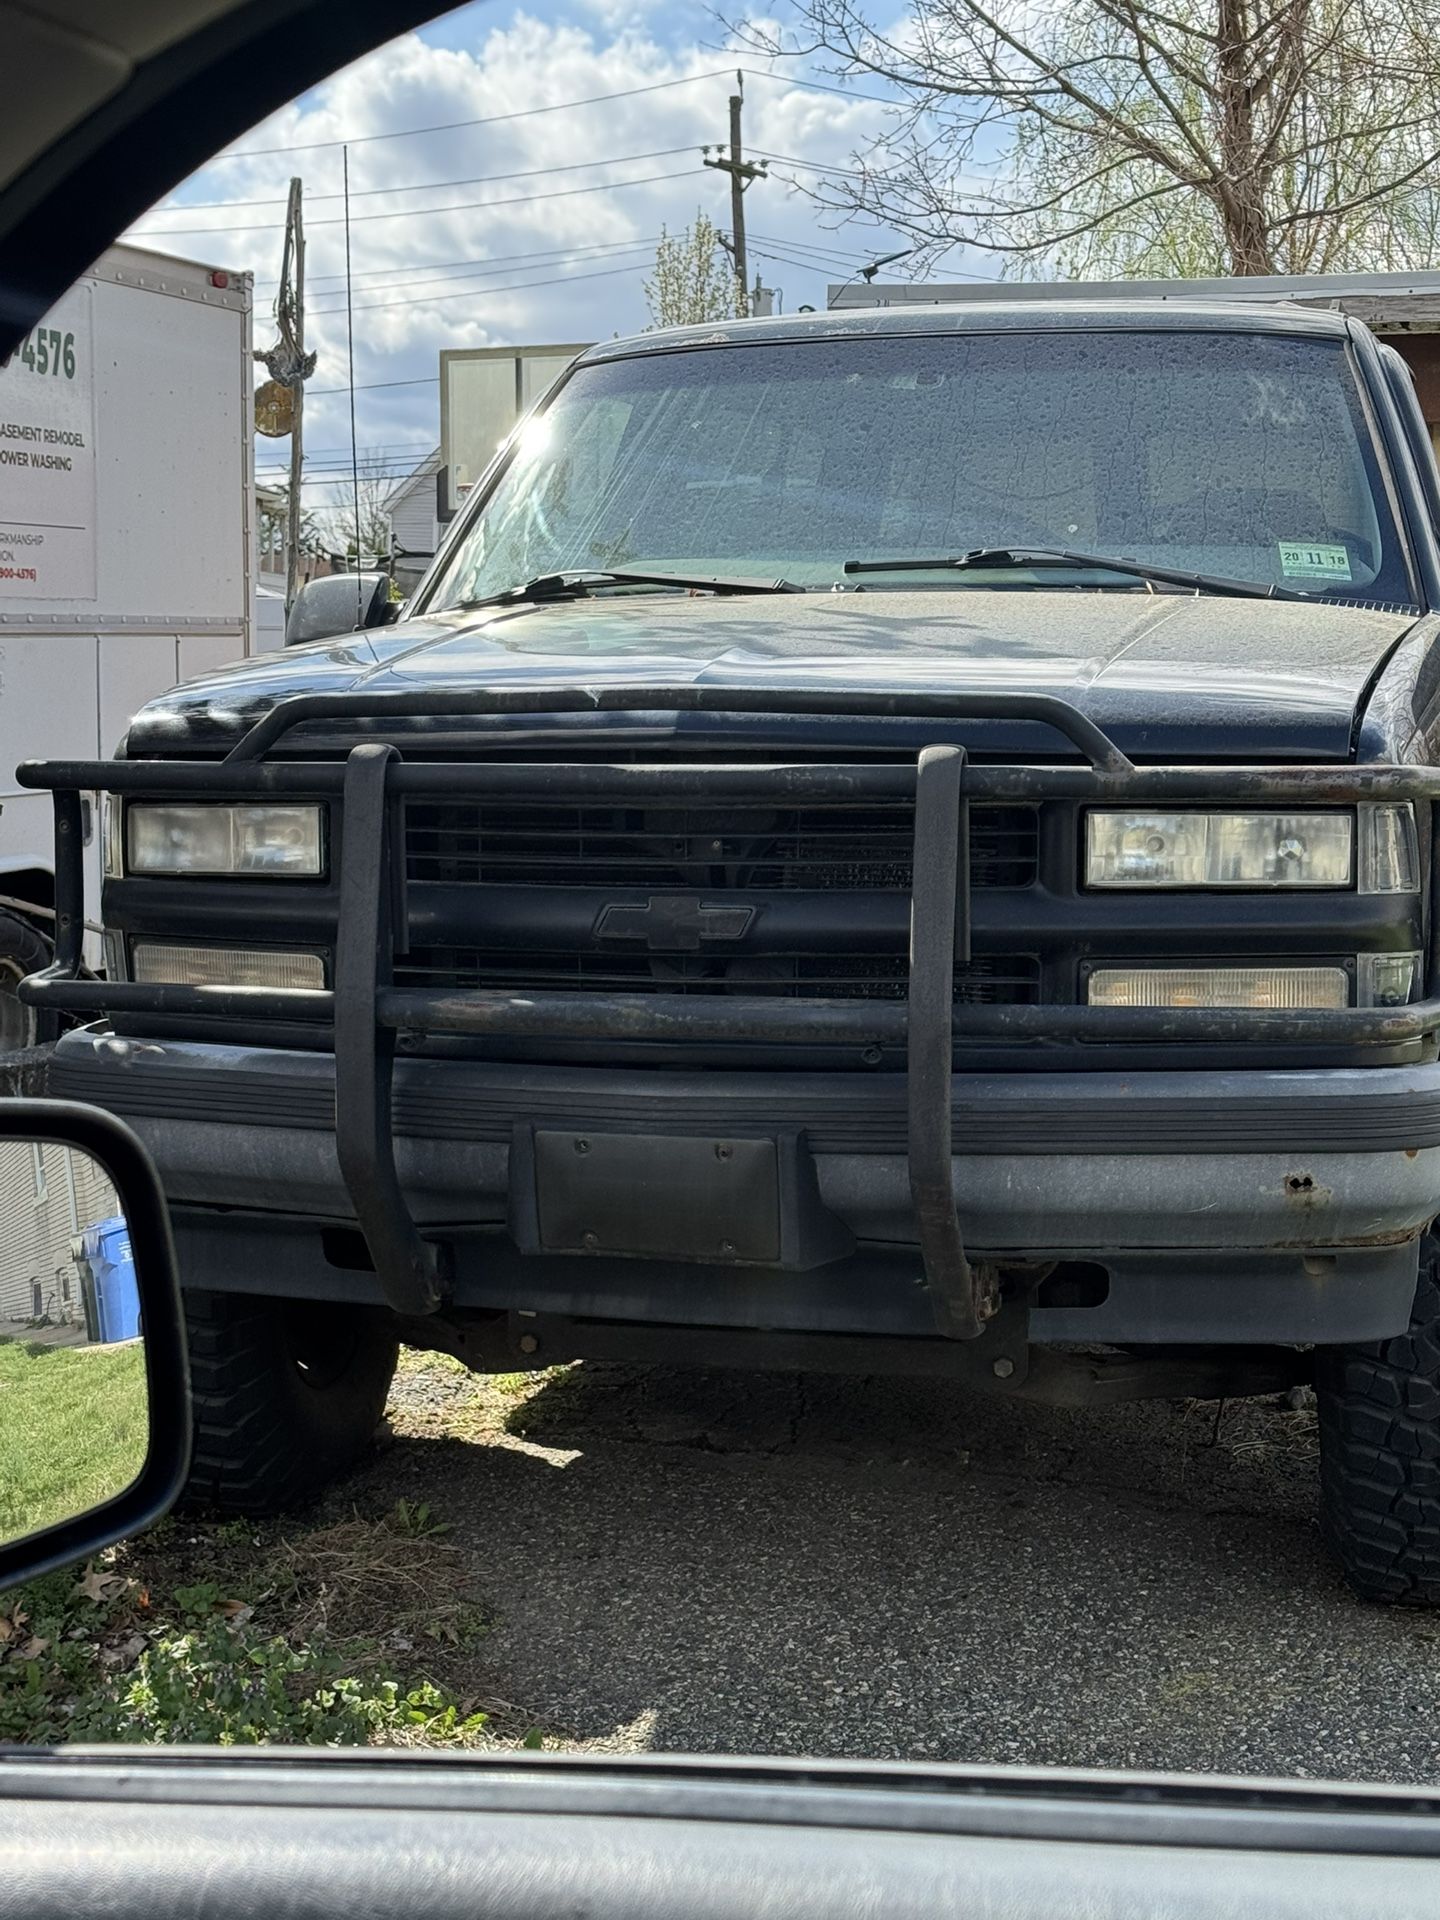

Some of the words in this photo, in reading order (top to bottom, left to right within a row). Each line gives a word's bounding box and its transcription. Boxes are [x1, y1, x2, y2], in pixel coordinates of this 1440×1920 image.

[43, 428, 85, 448] REMODEL
[0, 450, 29, 467] OWER
[30, 452, 72, 472] WASHING
[1284, 552, 1299, 561] 20
[1307, 552, 1324, 565] 11
[1329, 556, 1345, 565] 18
